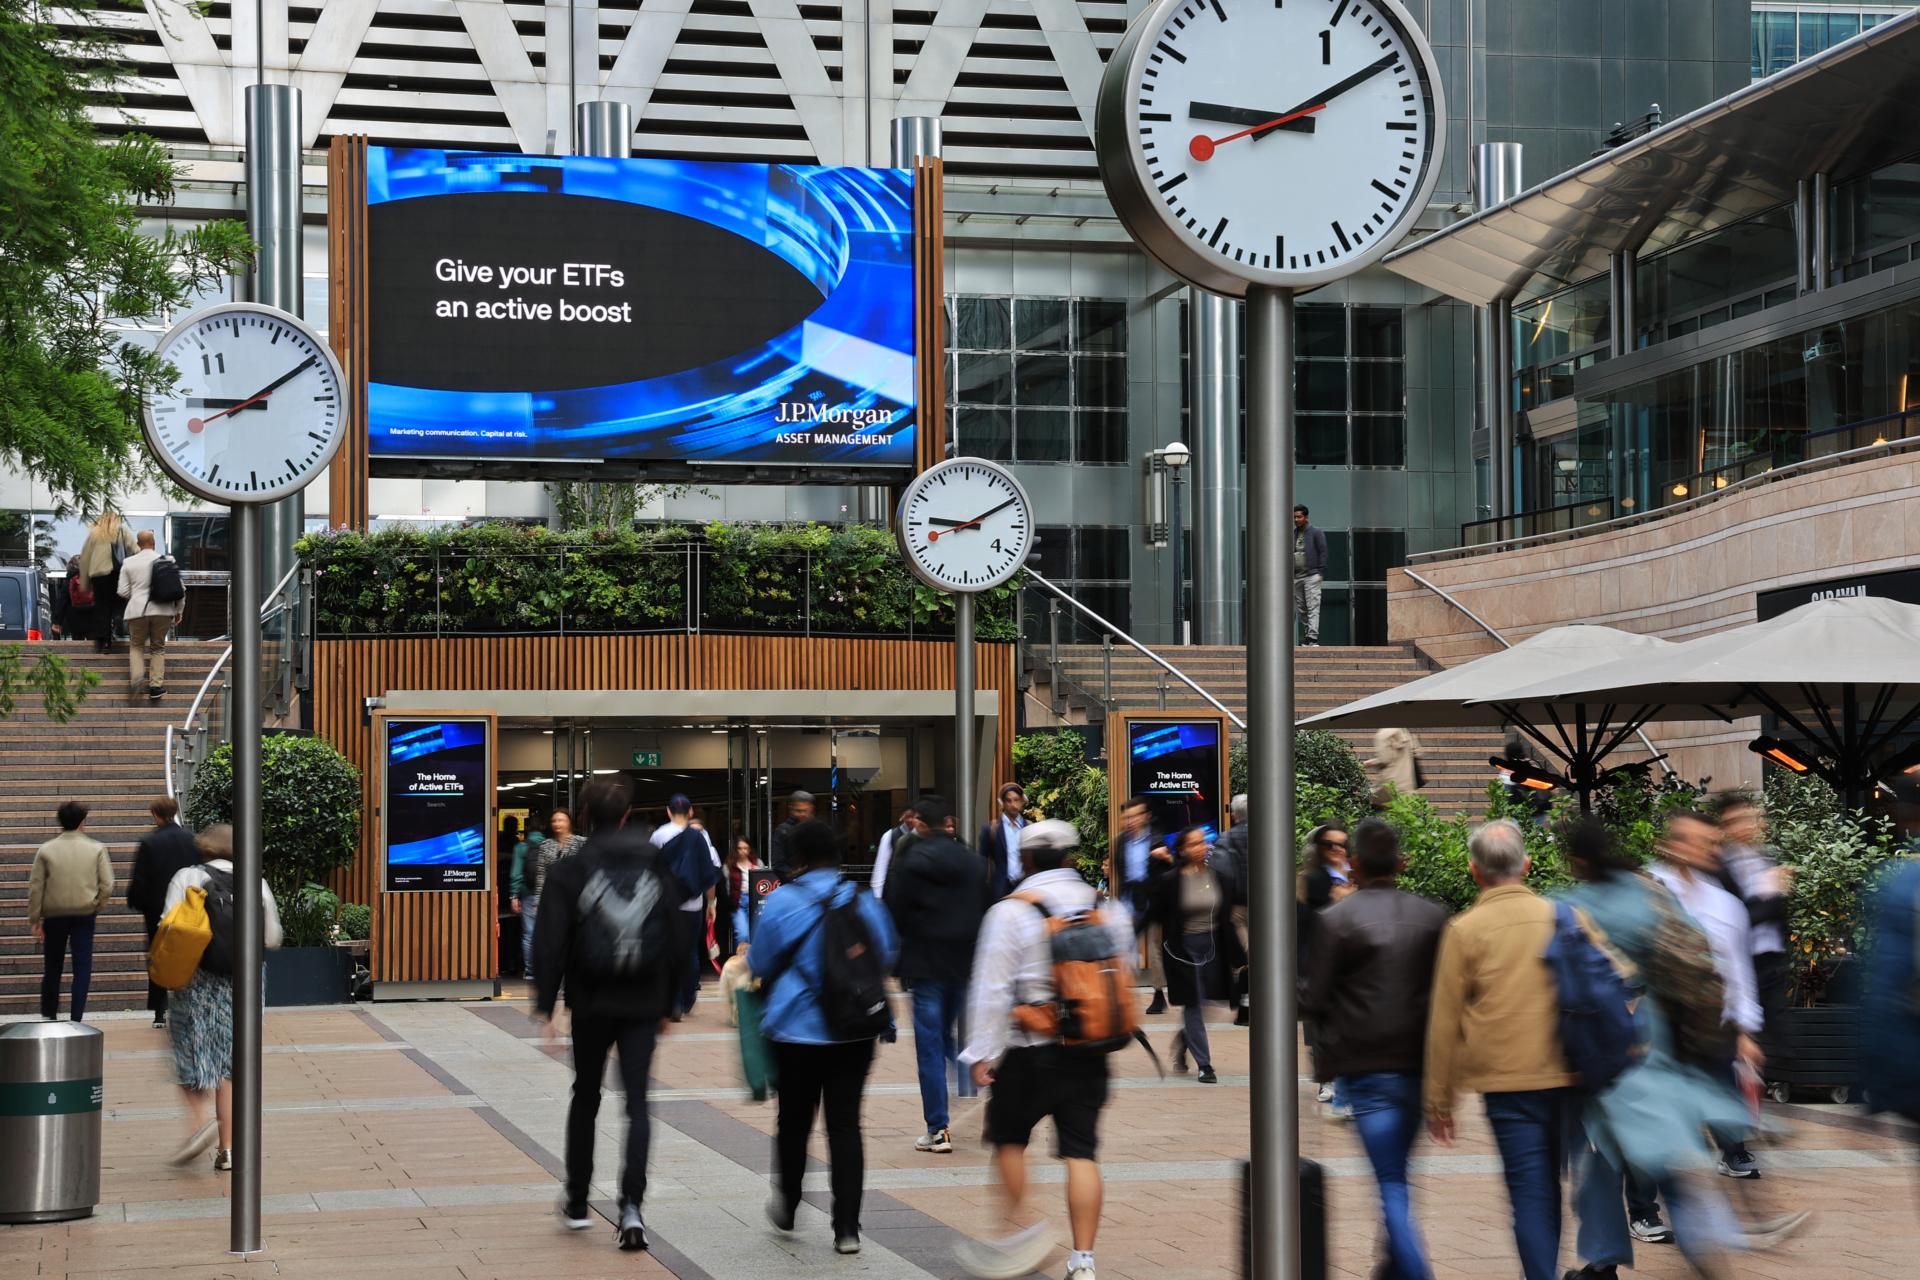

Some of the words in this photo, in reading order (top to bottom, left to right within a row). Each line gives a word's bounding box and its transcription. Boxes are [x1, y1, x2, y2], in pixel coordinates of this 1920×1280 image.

[1319, 30, 1331, 65] 1
[435, 258, 493, 283] Give
[499, 265, 556, 289] your
[563, 263, 625, 287] ETFs
[435, 299, 468, 318] an
[475, 297, 552, 320] active
[560, 298, 632, 323] boost
[200, 351, 225, 375] 11
[774, 402, 893, 431] J.P.Morgan
[390, 428, 424, 437] Marketing
[425, 428, 479, 437] communication.
[480, 429, 504, 438] Capital
[775, 433, 811, 444] ASSET
[814, 433, 893, 445] MANAGEMENT
[990, 538, 1001, 553] 4
[417, 773, 432, 781] The
[433, 773, 456, 781] Home
[1157, 771, 1170, 779] The
[409, 783, 417, 791] of
[418, 783, 443, 791] Active
[444, 782, 464, 791] ETFs
[1150, 781, 1158, 789] of
[1159, 781, 1180, 789] Active
[1181, 781, 1199, 789] ETFs
